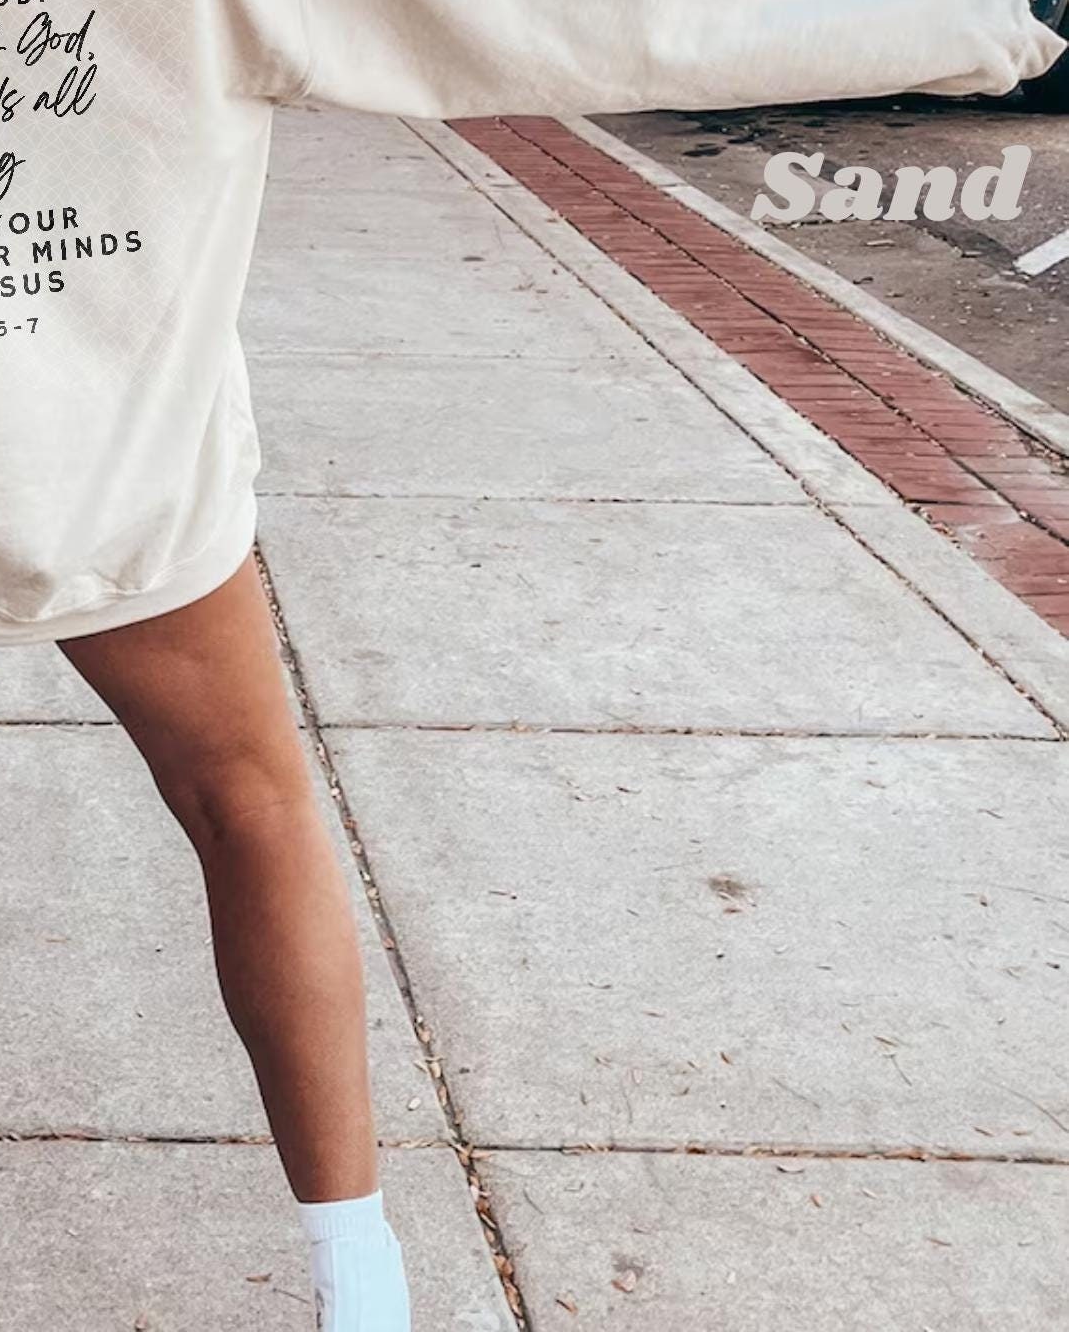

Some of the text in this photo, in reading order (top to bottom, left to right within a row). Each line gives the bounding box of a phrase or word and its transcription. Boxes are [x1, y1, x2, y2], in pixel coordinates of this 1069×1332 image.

[17, 10, 95, 66] God,
[33, 64, 97, 117] all
[32, 231, 141, 263] MINDS
